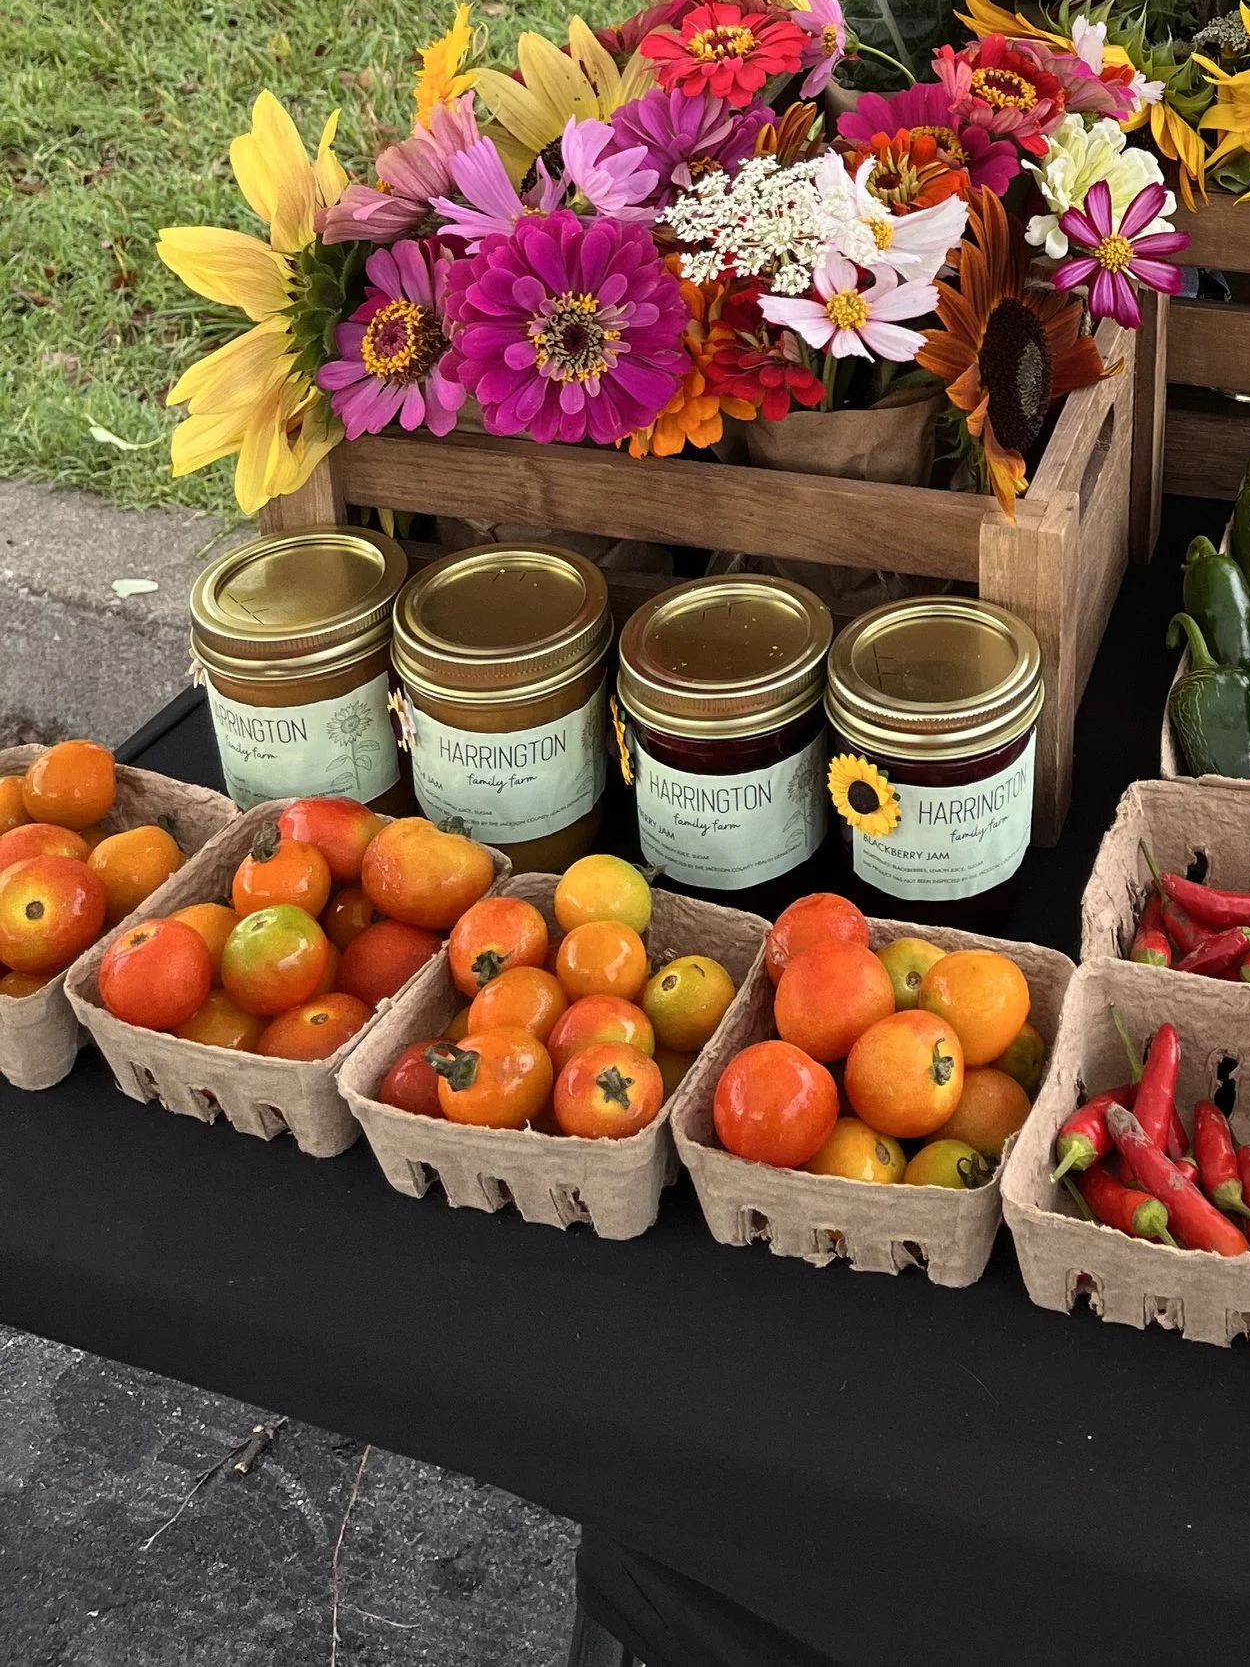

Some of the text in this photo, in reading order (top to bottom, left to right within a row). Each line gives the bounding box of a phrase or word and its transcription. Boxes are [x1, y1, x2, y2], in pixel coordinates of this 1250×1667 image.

[252, 746, 277, 759] farm
[440, 730, 566, 770] HARRINGTON
[467, 774, 508, 794] family
[510, 773, 537, 788] farm
[650, 771, 772, 814] HARRINGTON
[919, 762, 1028, 826] HARRINGTON
[658, 825, 675, 841] JAM
[673, 813, 711, 837] family
[712, 819, 741, 833] farm
[949, 816, 1009, 843] family farm
[863, 833, 950, 861] BLACKBERRY JAM
